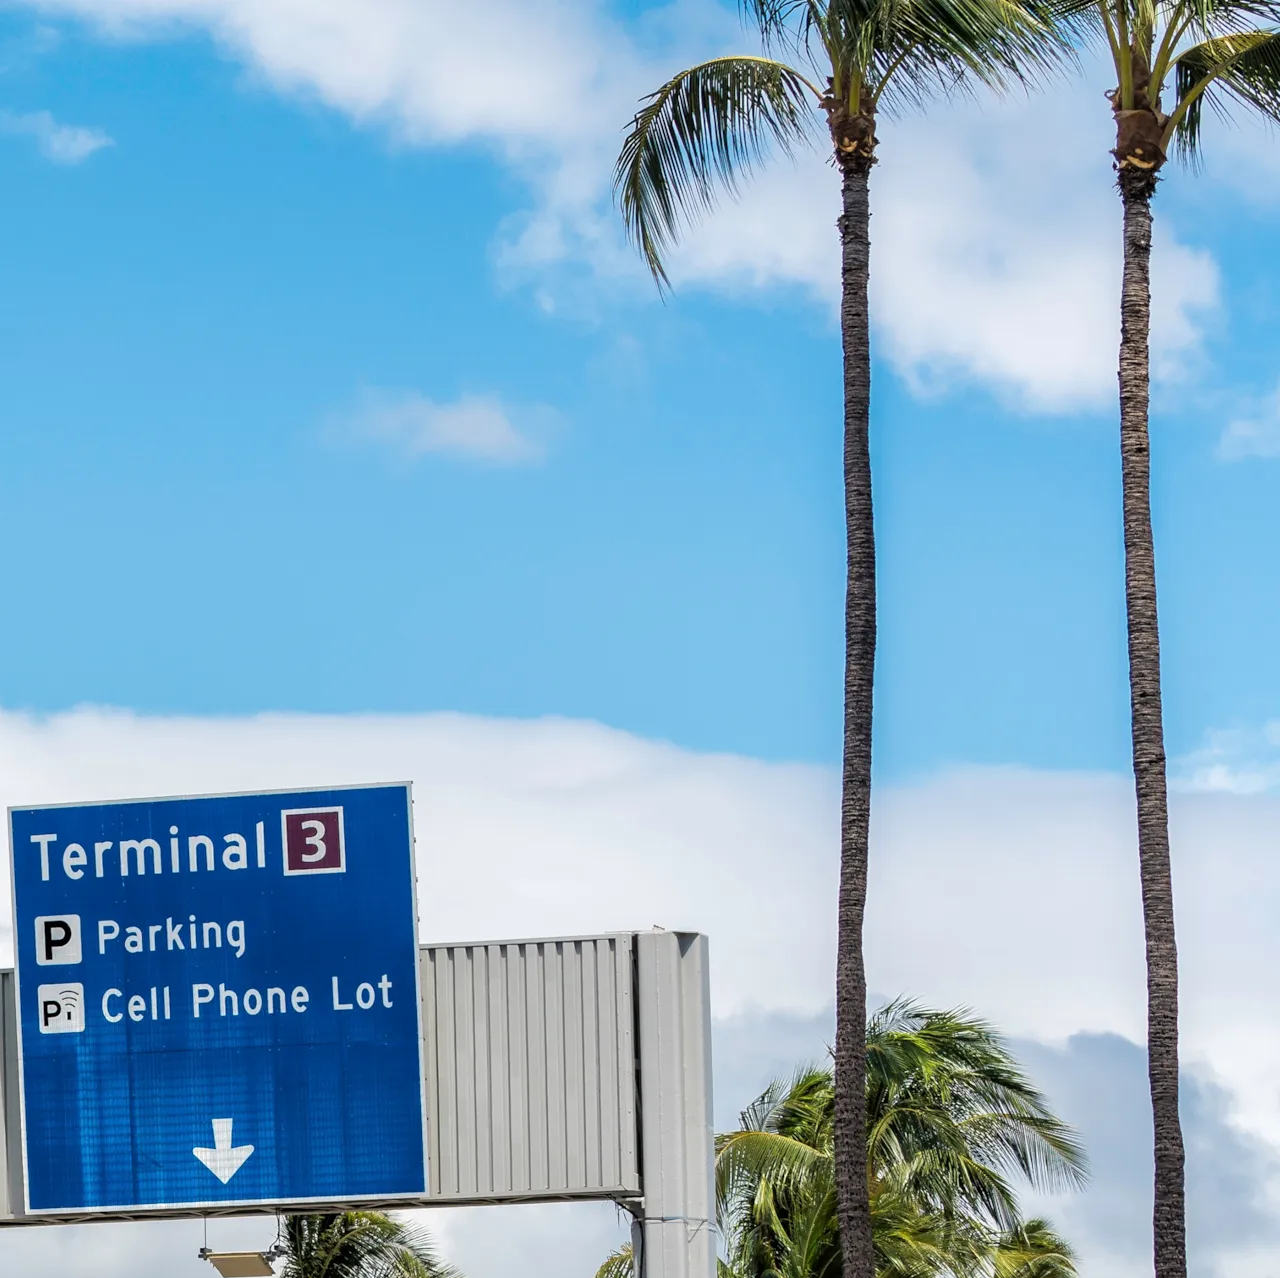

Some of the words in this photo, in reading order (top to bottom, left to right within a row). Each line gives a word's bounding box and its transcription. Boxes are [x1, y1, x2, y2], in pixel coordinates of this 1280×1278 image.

[30, 821, 267, 881] Terminal
[301, 819, 327, 863] 3
[97, 914, 246, 958] Parking
[101, 986, 171, 1023] Cell
[192, 982, 310, 1018] Phone
[331, 974, 393, 1011] Lot
